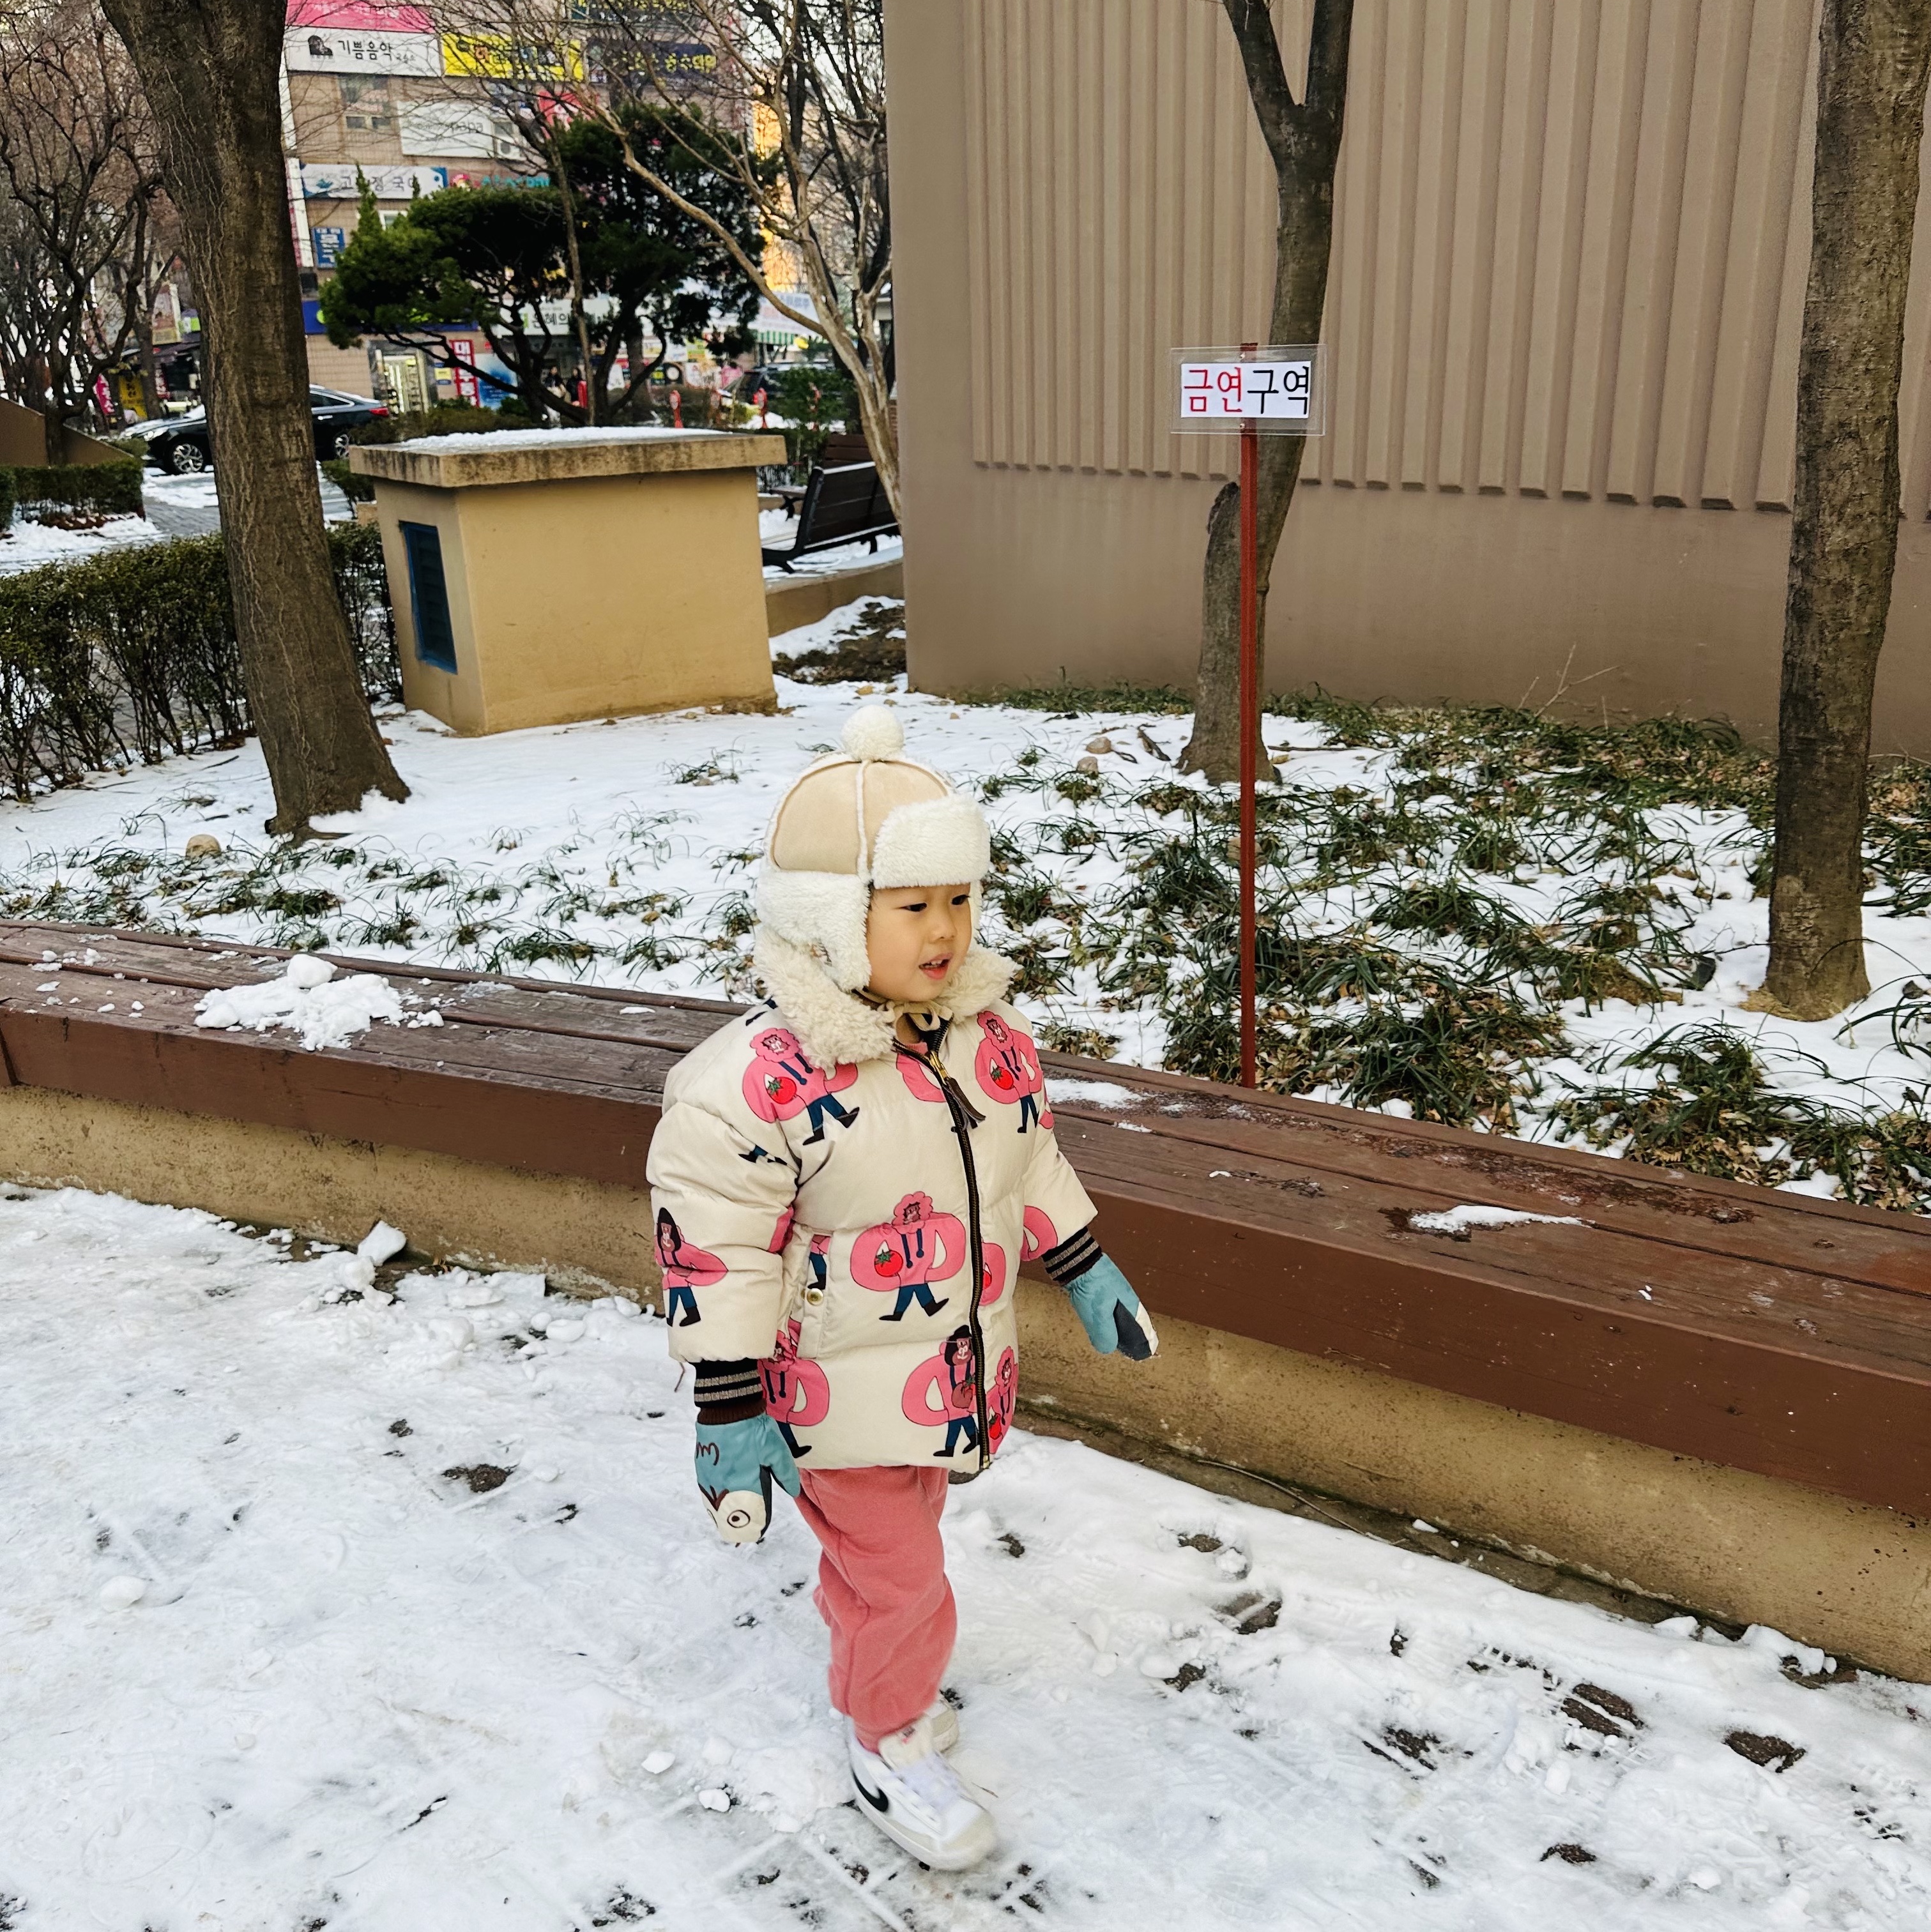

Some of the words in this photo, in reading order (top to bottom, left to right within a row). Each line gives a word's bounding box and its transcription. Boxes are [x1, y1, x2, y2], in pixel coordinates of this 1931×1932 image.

[338, 40, 392, 61] 기쁨음악
[340, 176, 384, 192] 고정
[1184, 366, 1309, 415] 금연구역
